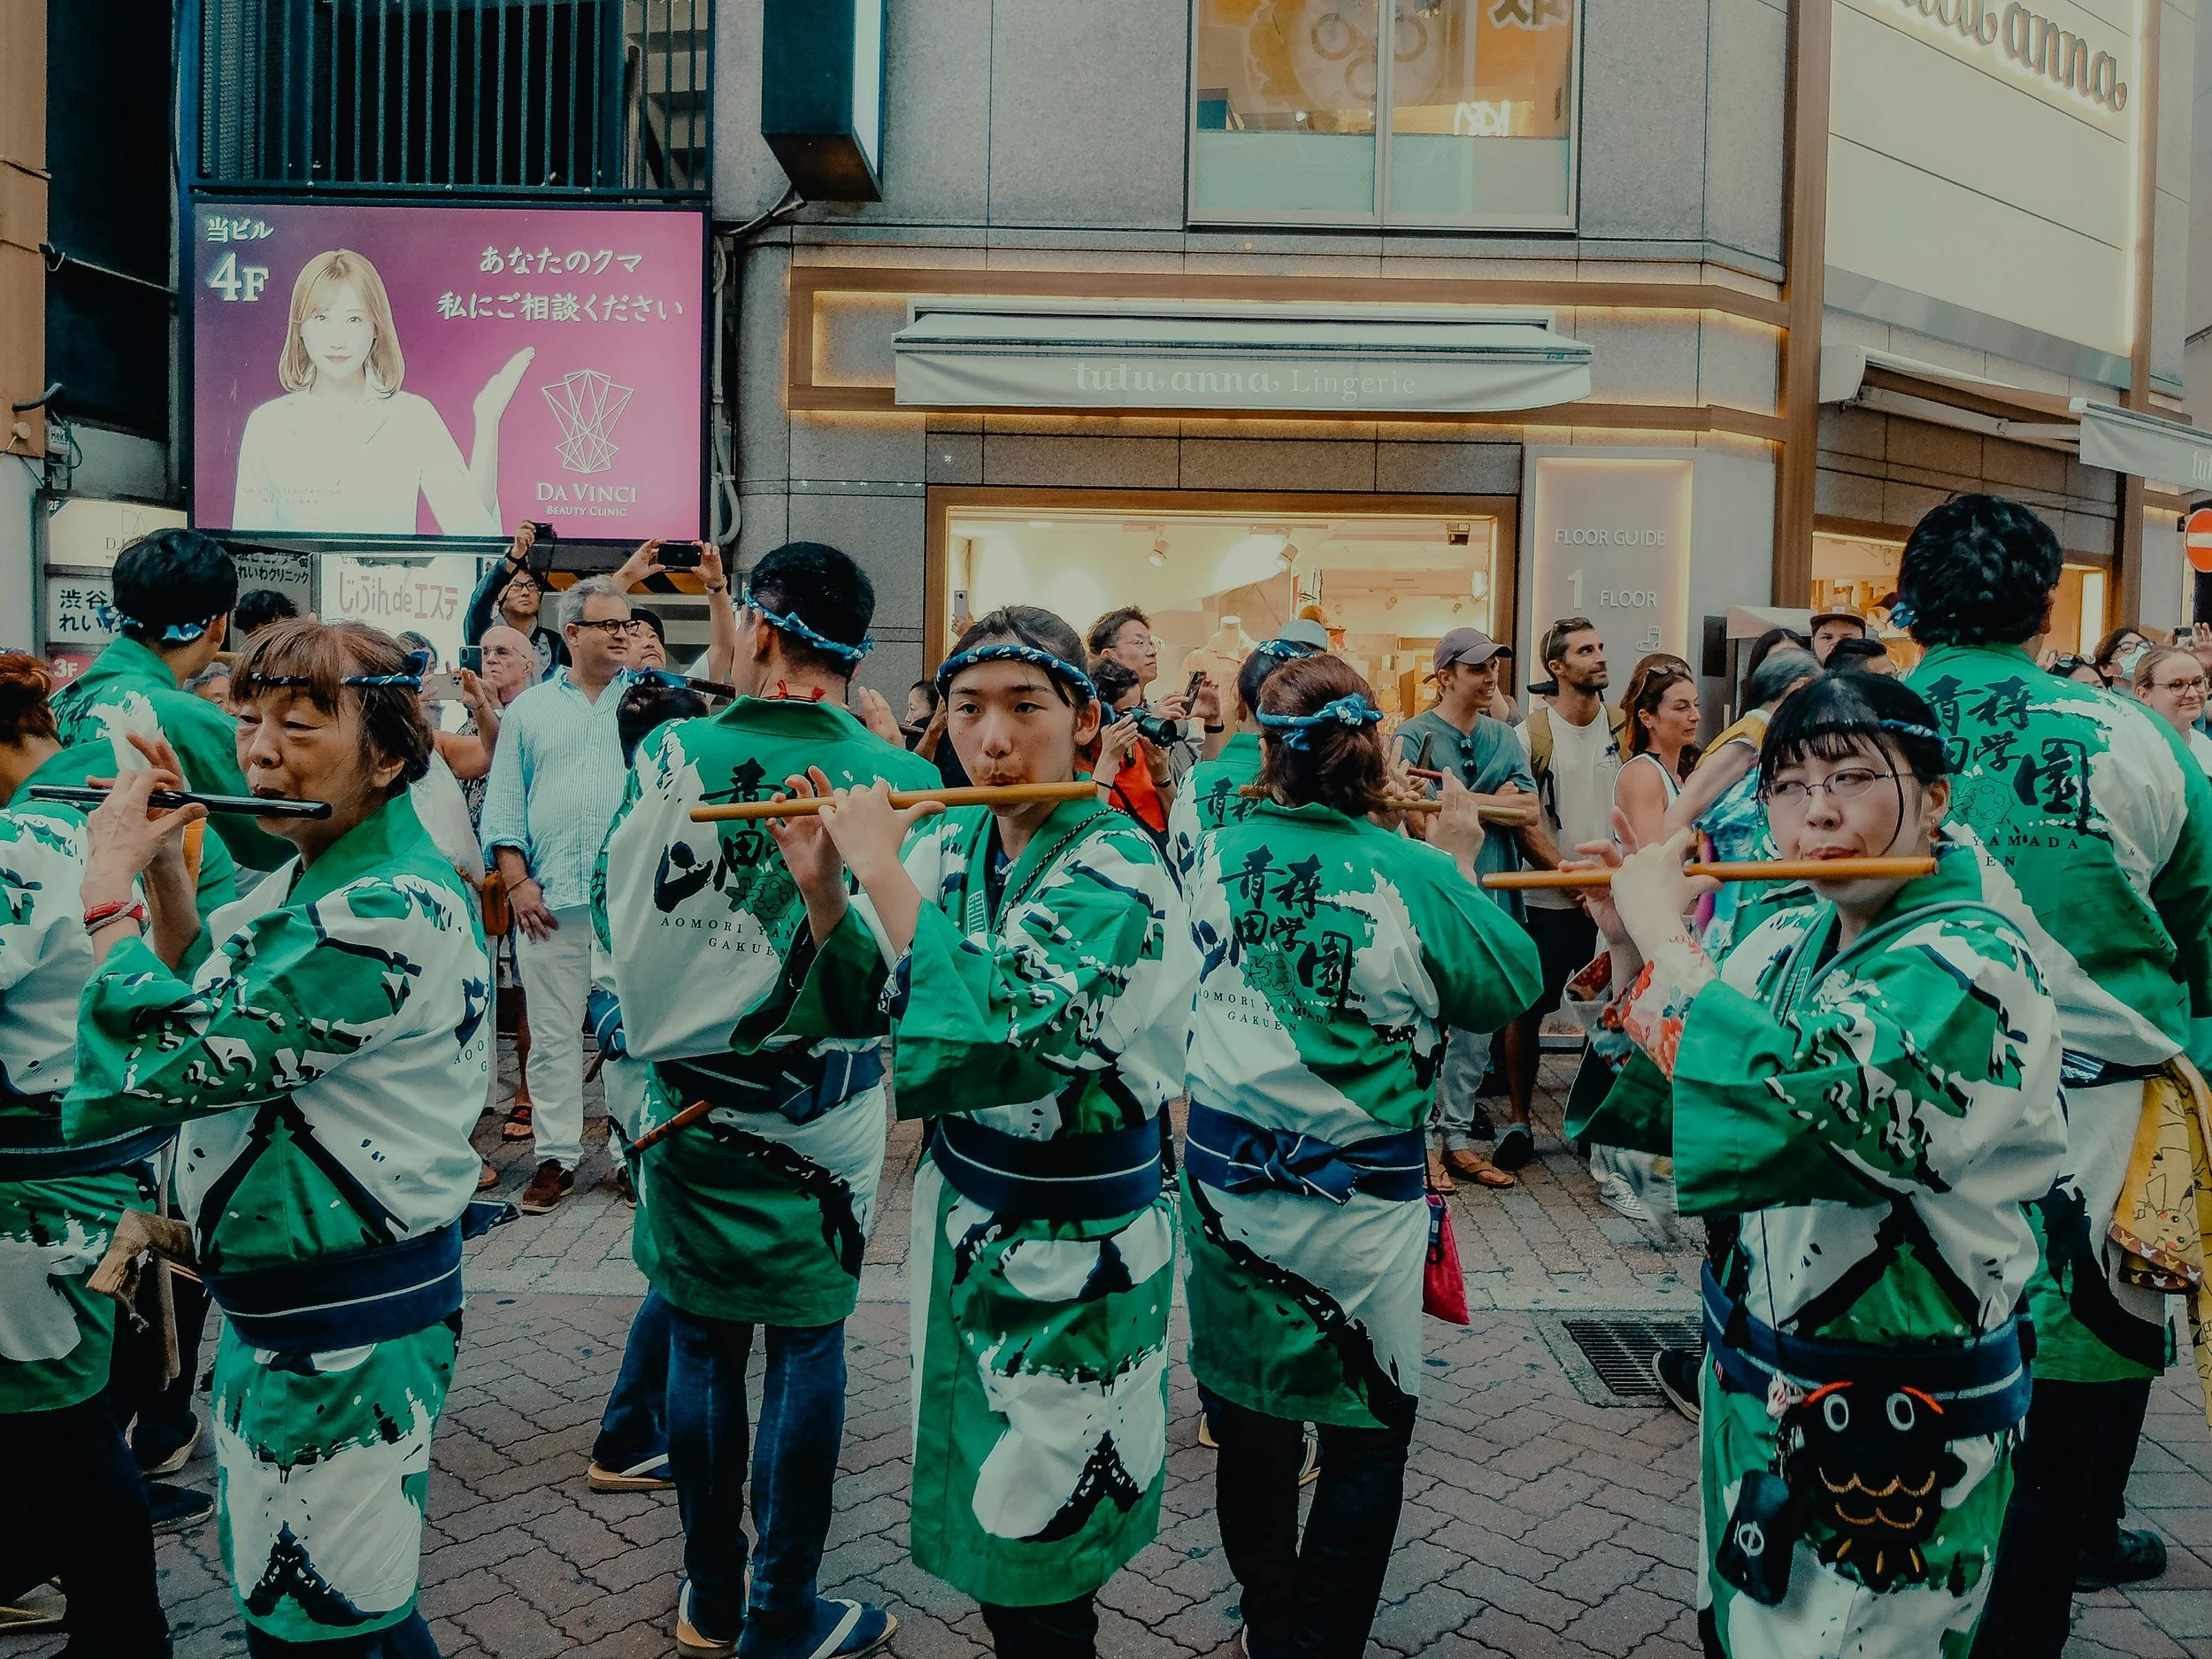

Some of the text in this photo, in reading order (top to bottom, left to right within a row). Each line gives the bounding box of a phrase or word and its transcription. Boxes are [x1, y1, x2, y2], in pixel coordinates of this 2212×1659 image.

[2002, 2, 2127, 111] anna
[206, 217, 274, 243] 当ビル
[479, 245, 644, 276] あなたのクマ
[209, 252, 270, 303] 4F
[436, 289, 684, 323] 私にご相談ください
[1070, 363, 1165, 392] tutu
[1291, 369, 1416, 403] Lingerie
[49, 500, 60, 511] 2F
[572, 483, 638, 503] VINCI
[1555, 529, 1666, 547] FLOOR GUIDE
[1567, 567, 1657, 610] 1 FLOOR
[54, 658, 78, 678] 3F
[661, 916, 795, 941] AOMORI YAM
[709, 937, 789, 958] GAKUEN
[1227, 1011, 1297, 1033] GAKUEN
